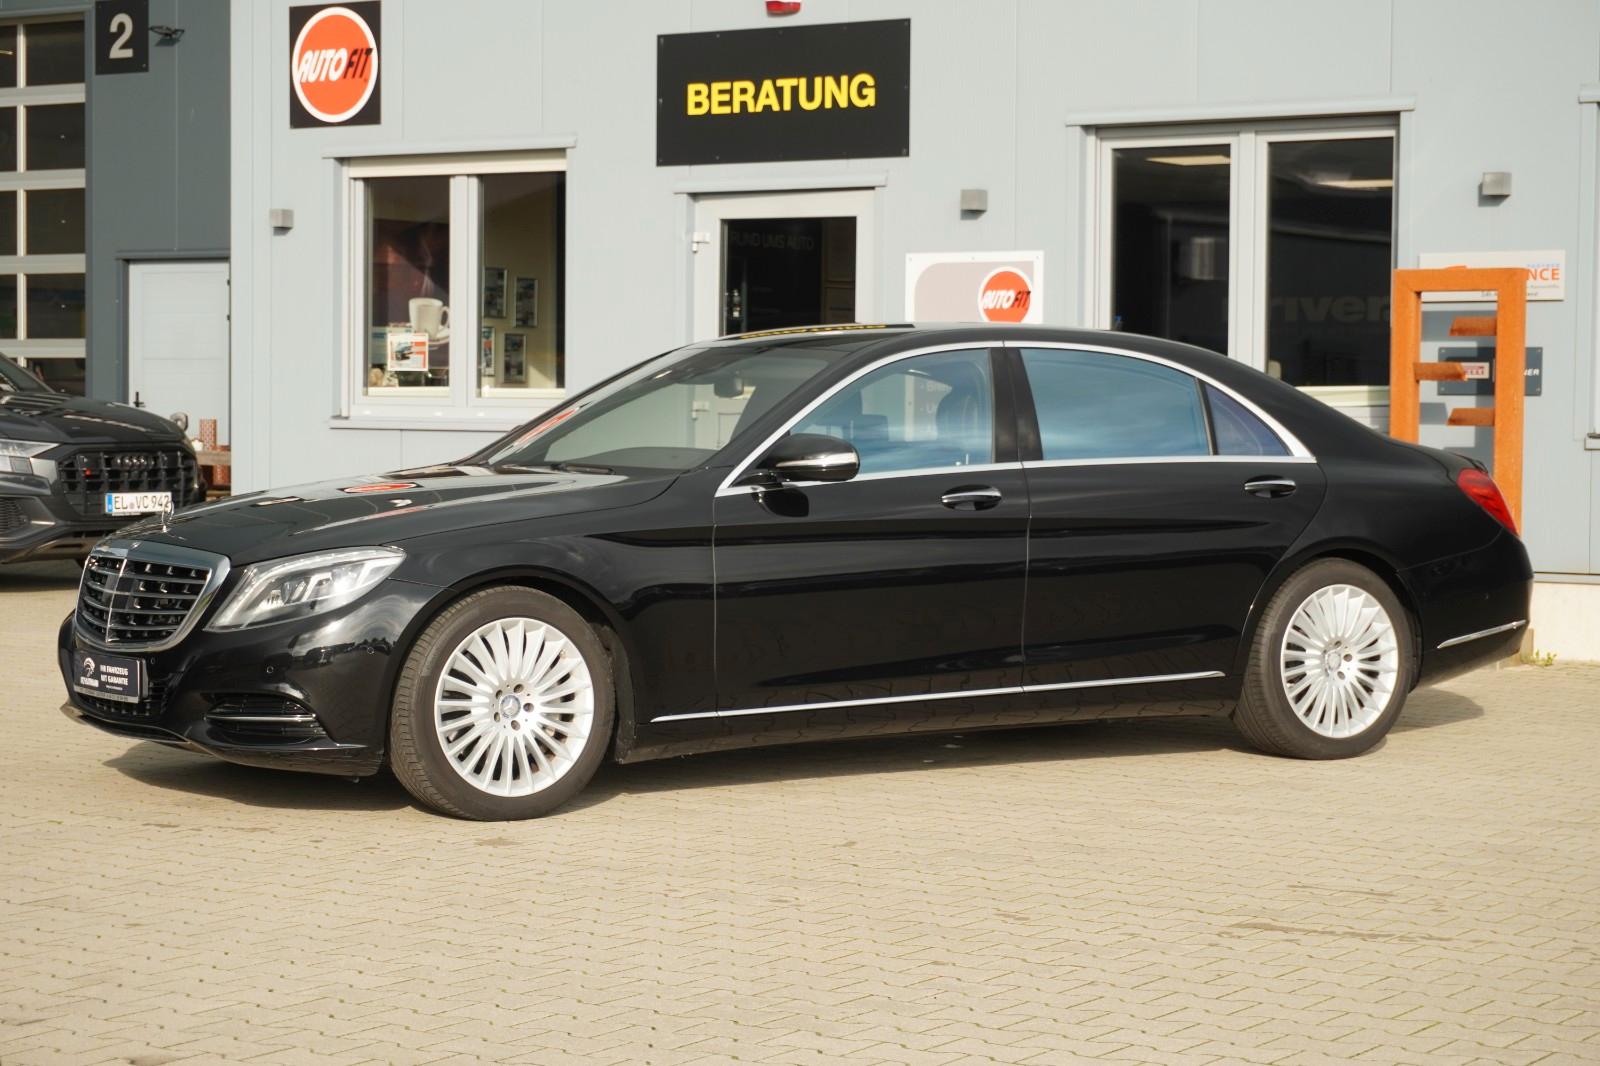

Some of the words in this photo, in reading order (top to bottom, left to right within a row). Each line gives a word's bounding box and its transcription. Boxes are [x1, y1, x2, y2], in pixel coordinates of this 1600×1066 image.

[109, 13, 133, 59] 2
[687, 73, 876, 116] BERATUNG
[1527, 267, 1561, 281] NCE
[114, 496, 128, 510] EL
